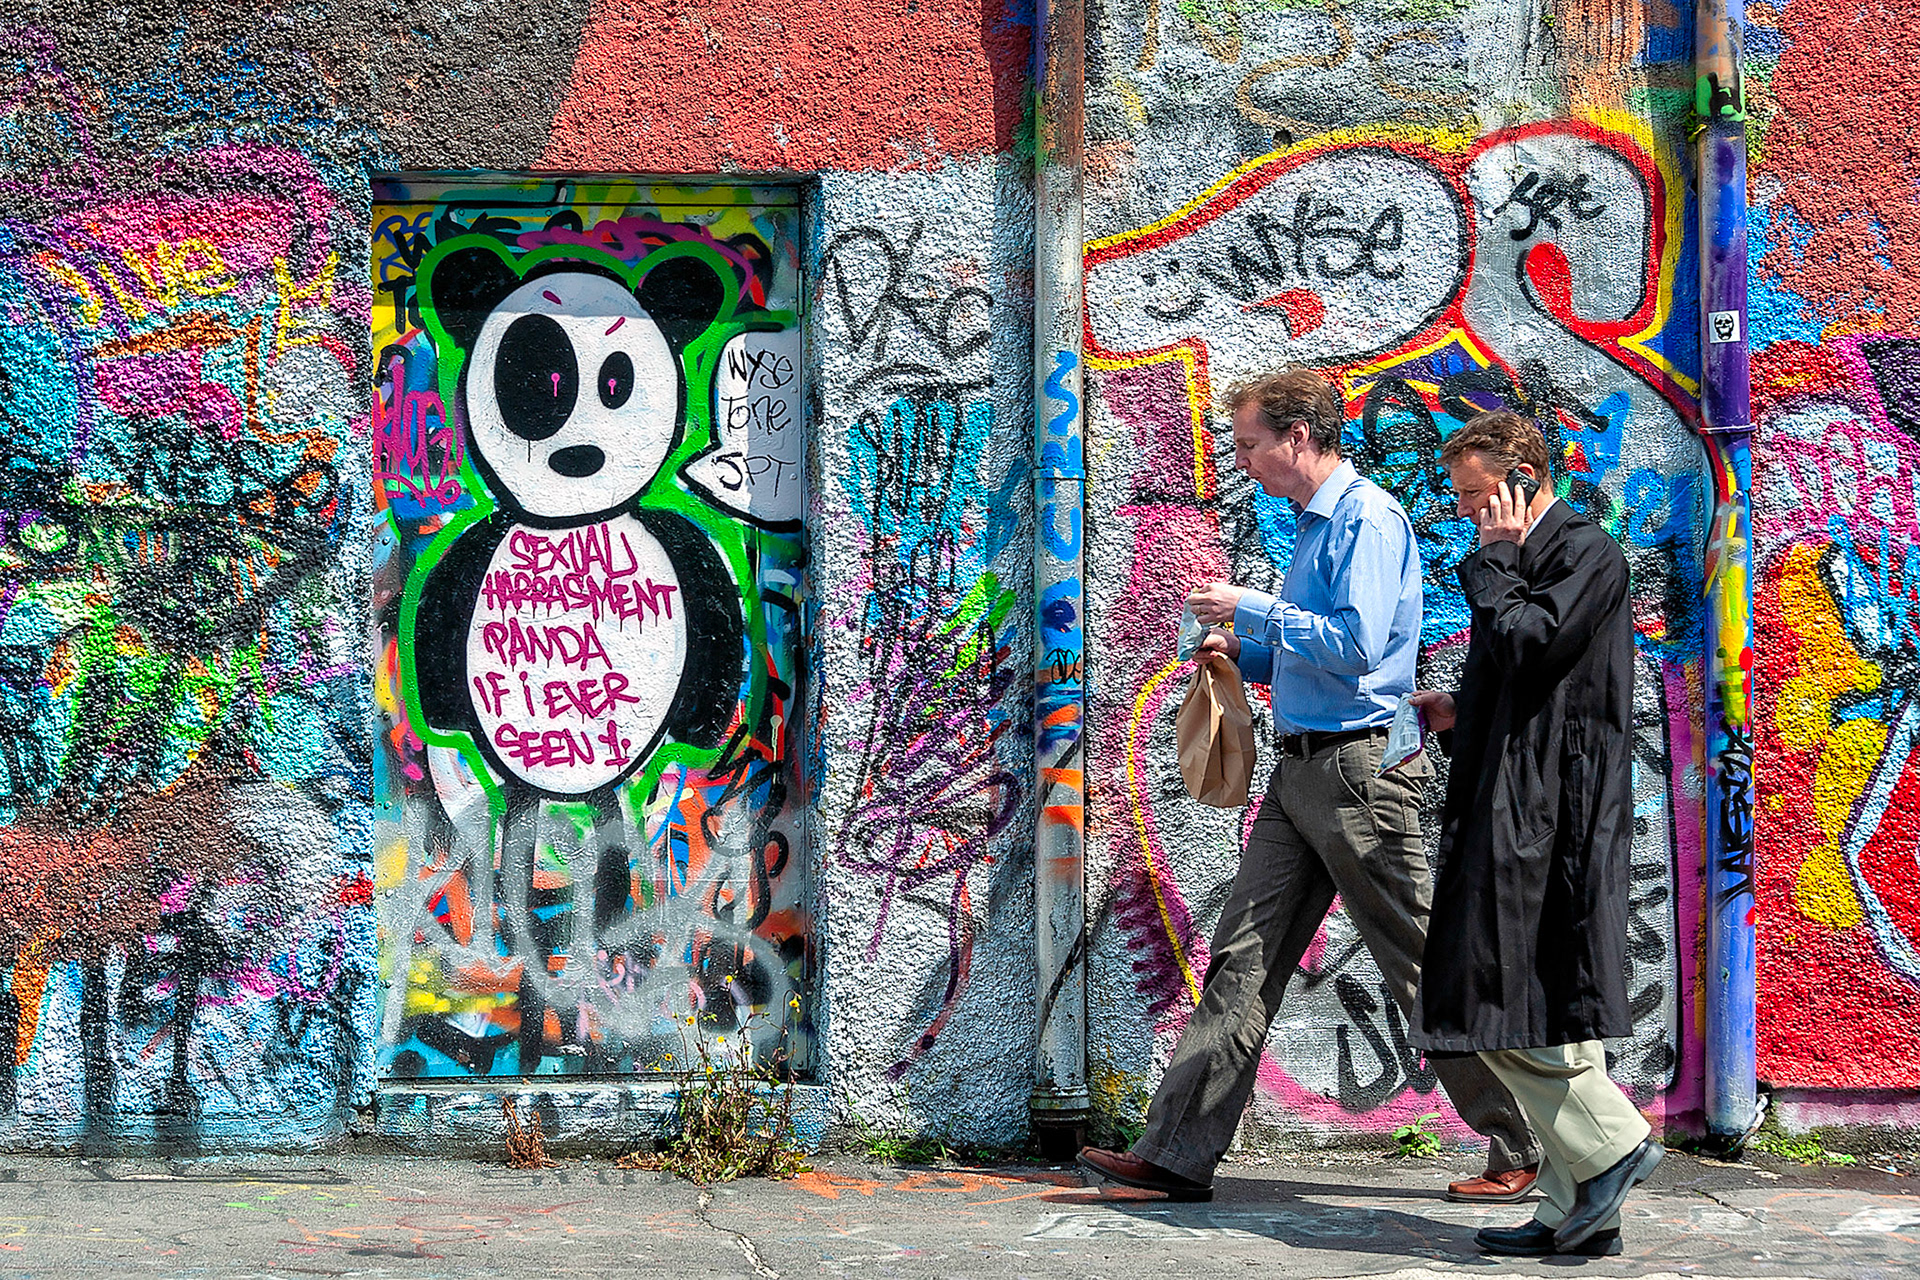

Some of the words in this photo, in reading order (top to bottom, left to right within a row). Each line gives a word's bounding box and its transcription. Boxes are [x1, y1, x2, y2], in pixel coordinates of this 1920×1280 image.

[509, 523, 638, 579] SEXUAL
[483, 617, 613, 671] PANDA
[473, 672, 511, 717] IF
[543, 672, 641, 719] EVER
[495, 723, 595, 767] SEEN
